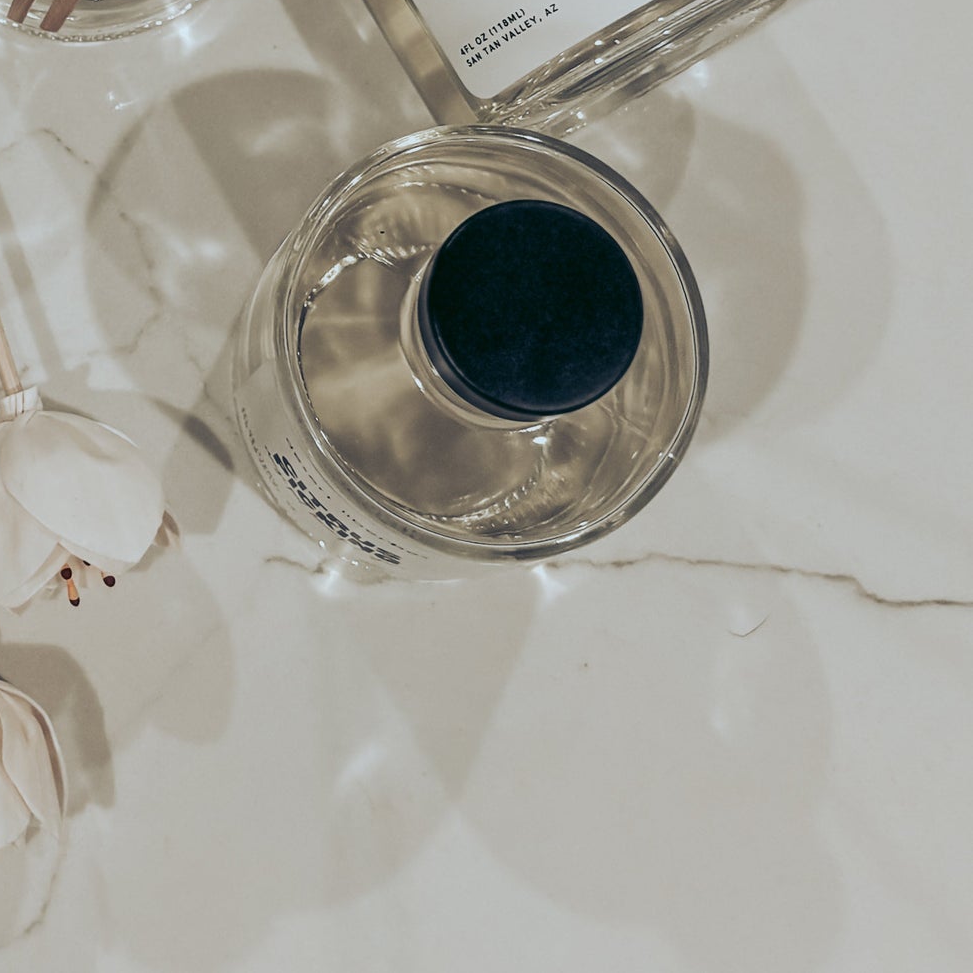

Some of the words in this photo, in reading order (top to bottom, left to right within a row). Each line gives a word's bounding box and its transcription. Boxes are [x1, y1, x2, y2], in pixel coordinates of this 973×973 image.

[459, 42, 475, 56] 4FL
[474, 32, 488, 46] OZ
[488, 8, 526, 37] (118ML)
[465, 51, 483, 68] SAN
[482, 39, 502, 55] TAN
[501, 15, 543, 43] VALLEY,
[544, 3, 559, 17] AZ
